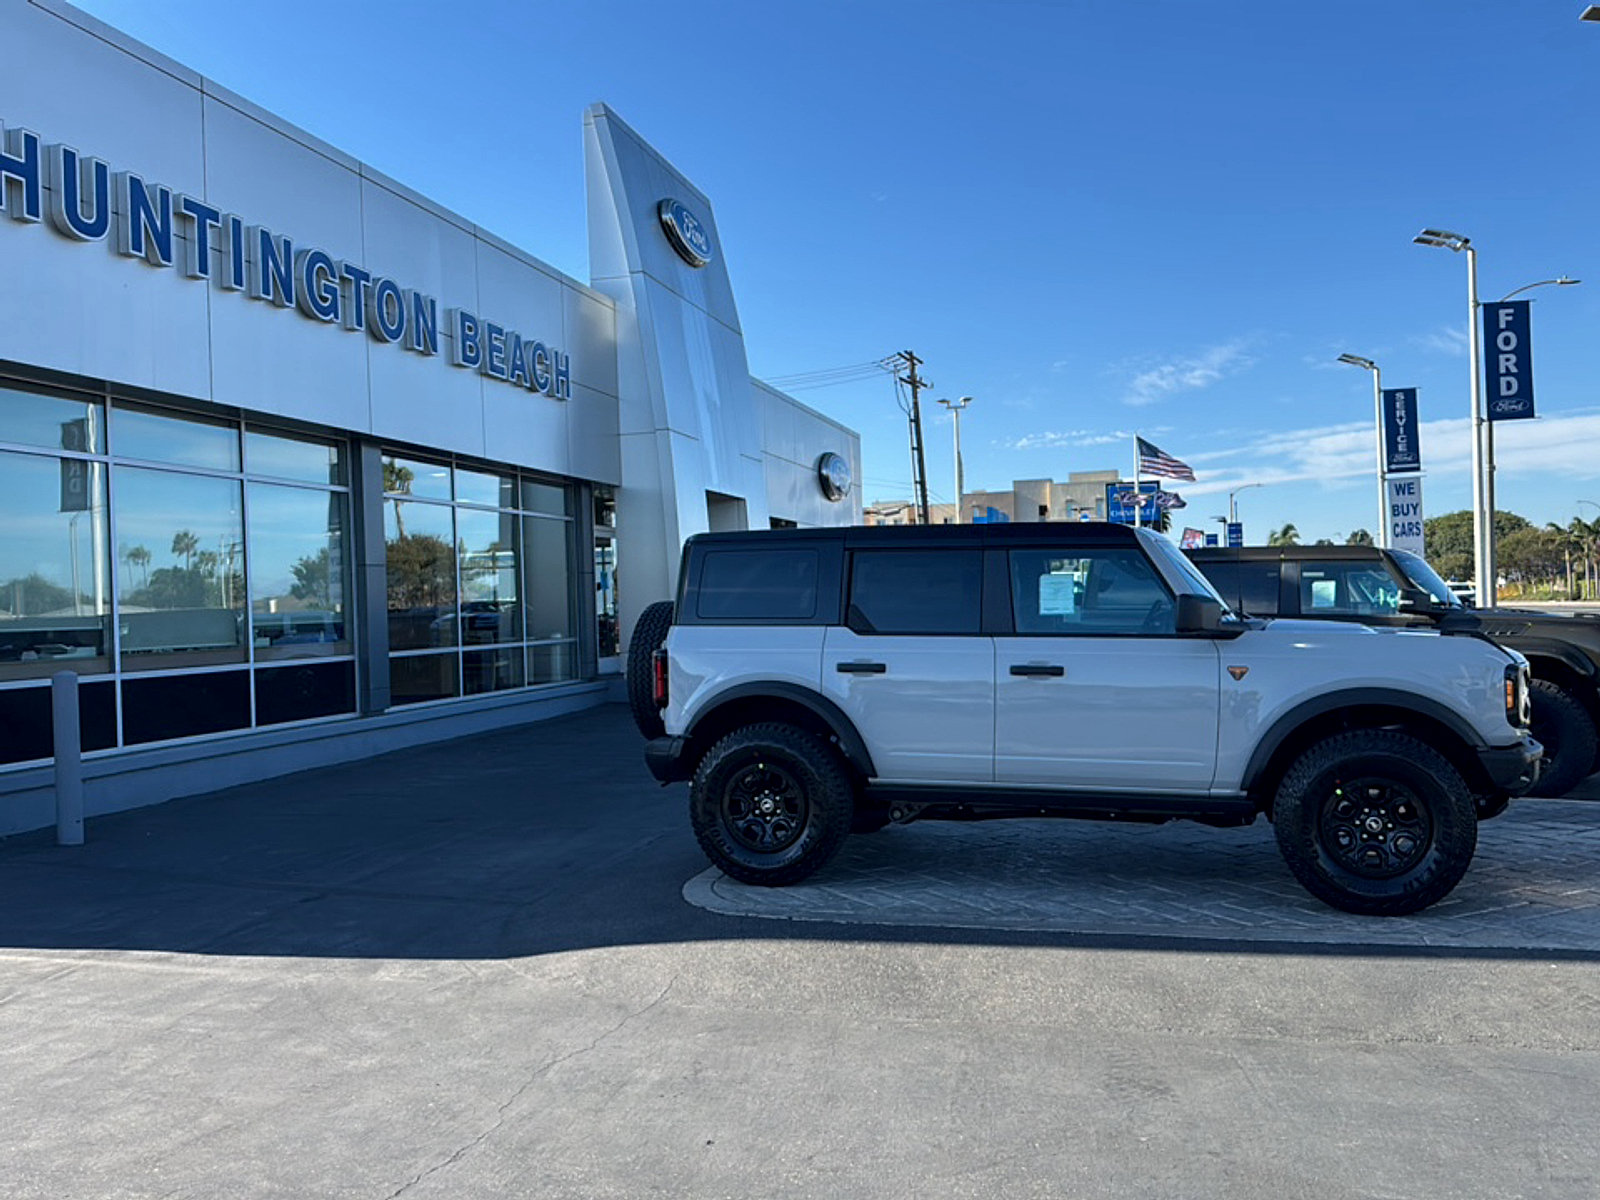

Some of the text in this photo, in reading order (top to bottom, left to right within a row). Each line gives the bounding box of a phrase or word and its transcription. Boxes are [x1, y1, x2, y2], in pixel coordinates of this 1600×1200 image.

[0, 118, 572, 399] HUNTINGTON BEACH
[1496, 308, 1519, 396] FORD
[1496, 399, 1523, 412] Ford
[1395, 391, 1407, 452] SERVICE
[1394, 482, 1415, 496] WE
[1392, 503, 1419, 518] BUY
[1393, 522, 1421, 538] CARS
